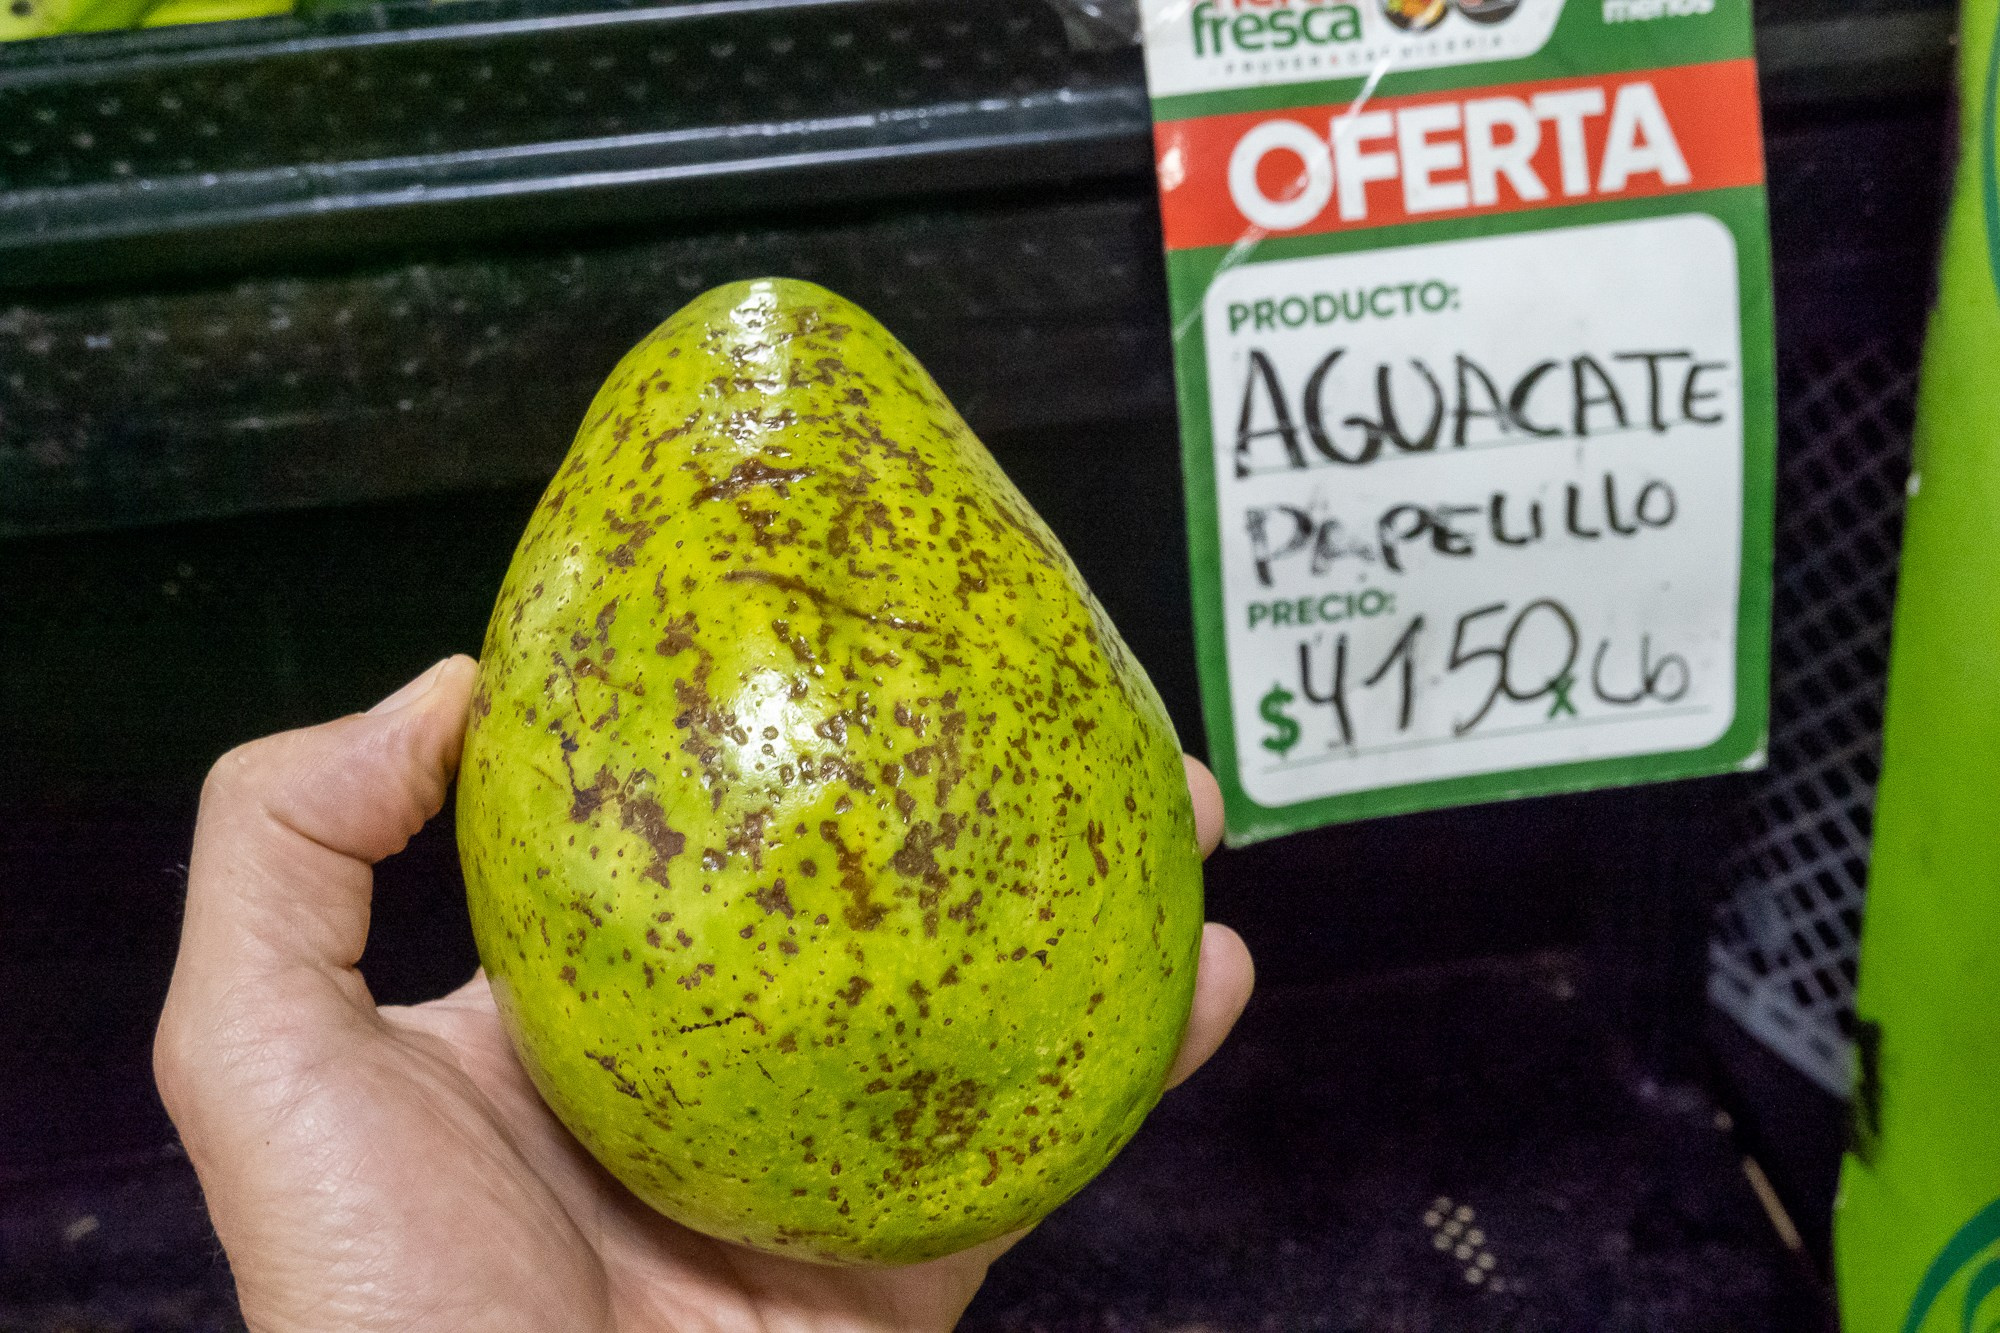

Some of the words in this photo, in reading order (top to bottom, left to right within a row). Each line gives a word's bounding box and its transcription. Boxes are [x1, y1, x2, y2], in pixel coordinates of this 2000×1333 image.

[1192, 1, 1362, 57] fresca
[1228, 81, 1692, 231] OFERTA
[1228, 279, 1461, 334] PRODUCTO:
[1235, 347, 1729, 479] AGUACATE
[1247, 588, 1396, 630] PRECIO:
